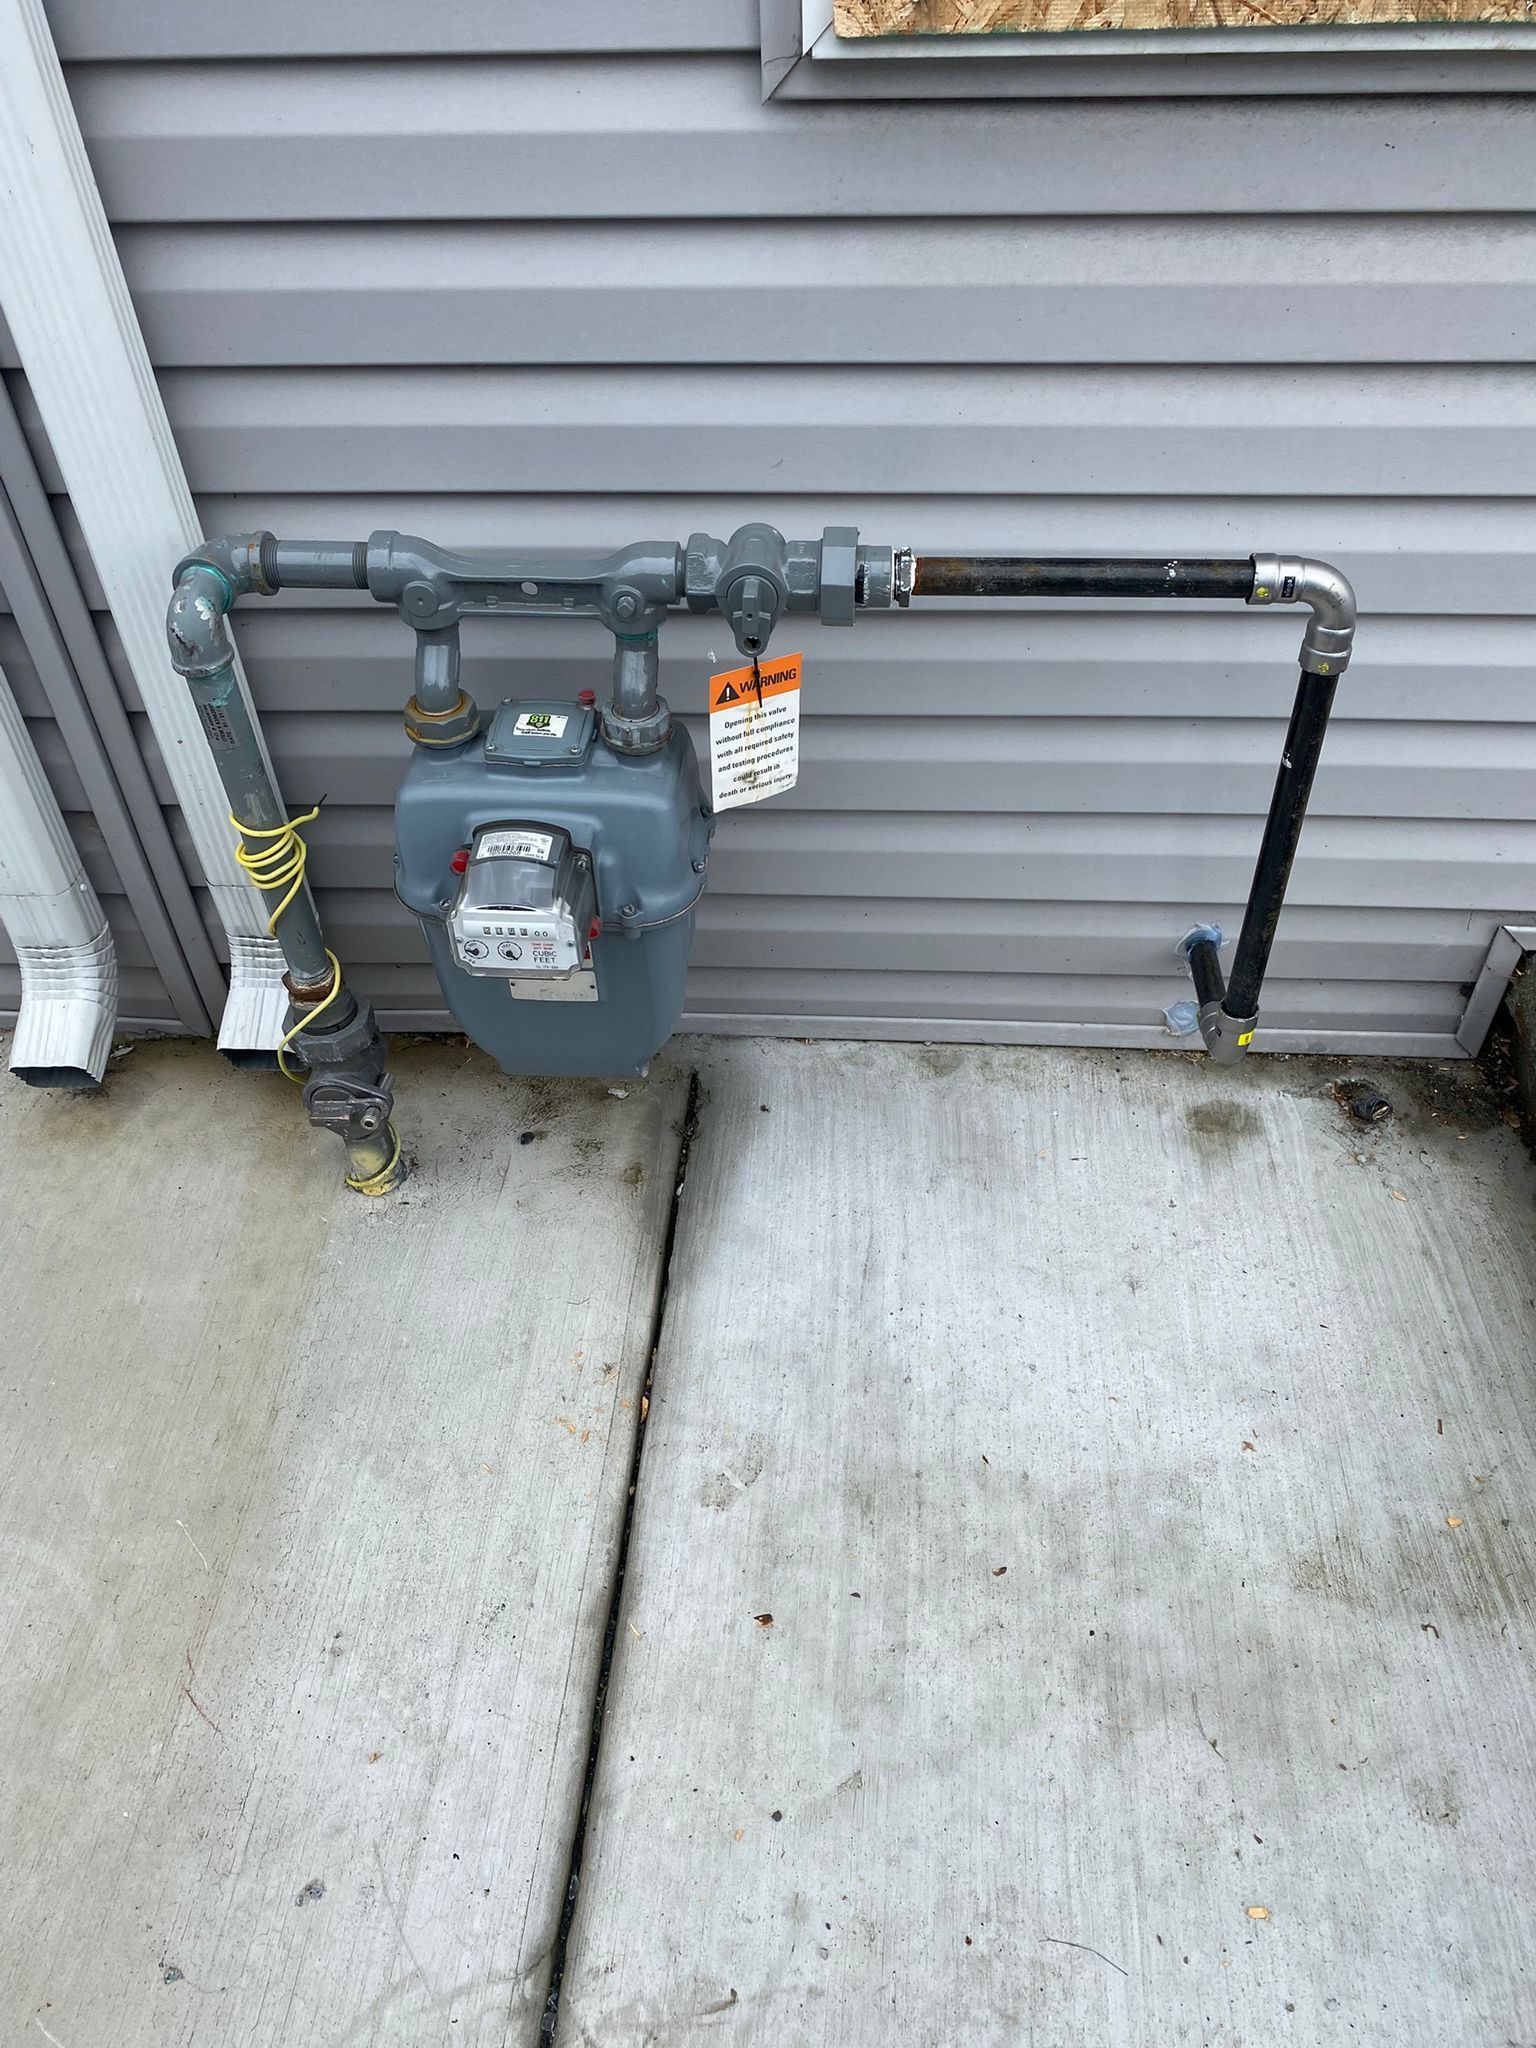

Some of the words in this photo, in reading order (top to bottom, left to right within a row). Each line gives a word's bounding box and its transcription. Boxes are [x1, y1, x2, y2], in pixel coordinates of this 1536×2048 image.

[740, 668, 796, 693] WARNING
[530, 714, 550, 724] 811
[725, 716, 753, 729] Opening
[754, 712, 767, 720] this
[769, 706, 787, 716] valve
[716, 733, 742, 745] without
[743, 729, 754, 737] full
[756, 718, 796, 733] compliance
[717, 749, 733, 759] with
[734, 746, 743, 754] all
[745, 737, 773, 750] required
[774, 732, 794, 742] safety
[718, 763, 731, 772] and
[732, 757, 755, 768] testing
[757, 746, 793, 763] procedures
[719, 789, 738, 799] death
[748, 780, 772, 790] serious
[774, 773, 793, 783] injury.
[733, 771, 752, 782] could
[754, 765, 772, 776] result
